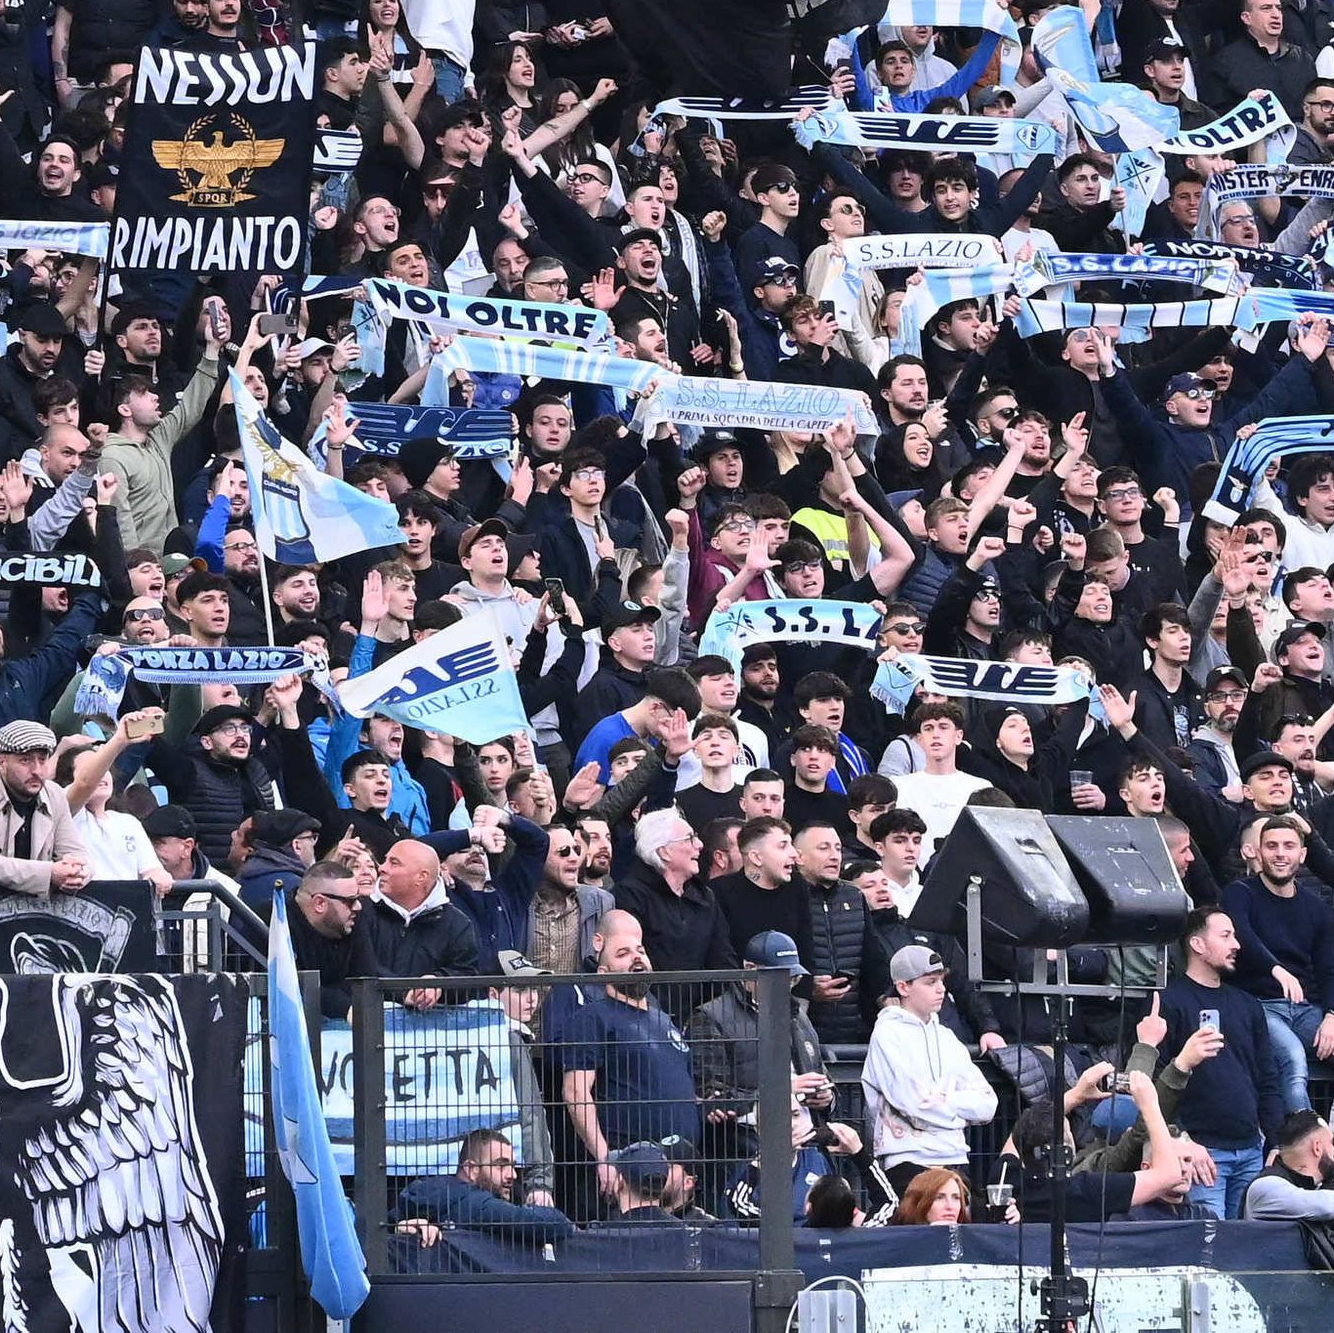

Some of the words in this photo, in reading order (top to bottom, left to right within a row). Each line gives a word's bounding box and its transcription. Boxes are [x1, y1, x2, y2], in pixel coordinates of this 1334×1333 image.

[133, 42, 317, 108] NESSUN
[1188, 92, 1278, 148] OLTRE
[1210, 169, 1269, 192] MISTER
[197, 190, 229, 203] SPQR
[1221, 190, 1256, 201] CURVA
[111, 215, 303, 270] RIMPIANTO
[1051, 255, 1091, 275] S.S.
[1117, 256, 1198, 276] LAZIO
[373, 280, 449, 320] NOI
[466, 300, 598, 338] OLTRE
[675, 378, 727, 410] S.S.
[733, 381, 842, 419] LAZIO
[678, 411, 711, 423] PRIMA
[710, 412, 761, 426] SQUADRA
[761, 416, 795, 428] DELLA
[764, 606, 832, 635] S.S.
[131, 649, 210, 670] FORZA
[215, 650, 287, 670] LAZIO
